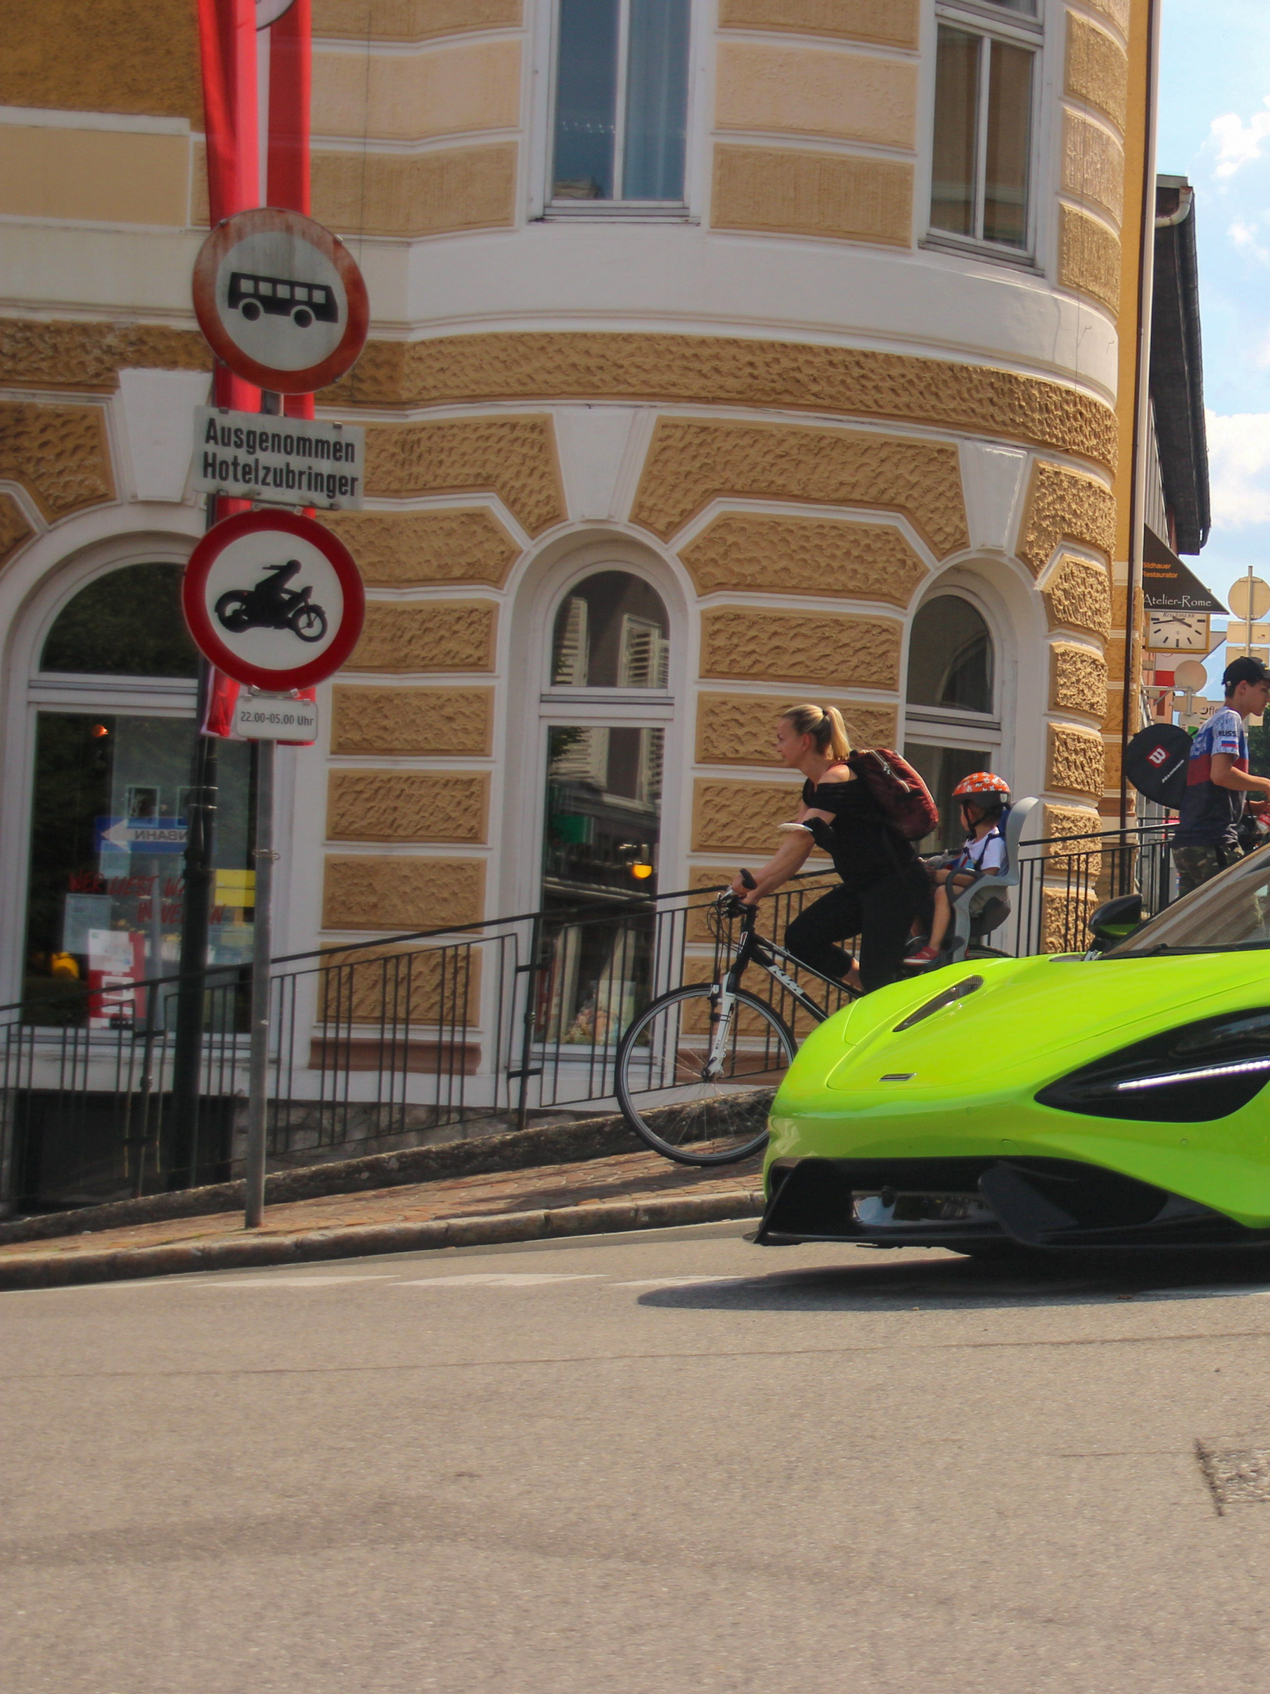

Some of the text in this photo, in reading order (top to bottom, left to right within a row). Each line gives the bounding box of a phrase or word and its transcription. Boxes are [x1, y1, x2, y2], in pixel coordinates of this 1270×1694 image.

[205, 417, 355, 463] Ausgenommen
[203, 451, 359, 499] Hotelzubringer
[1144, 593, 1212, 608] Atelier-Rome
[241, 711, 314, 726] 22.00-05.00 Uhr
[768, 964, 805, 995] KTM
